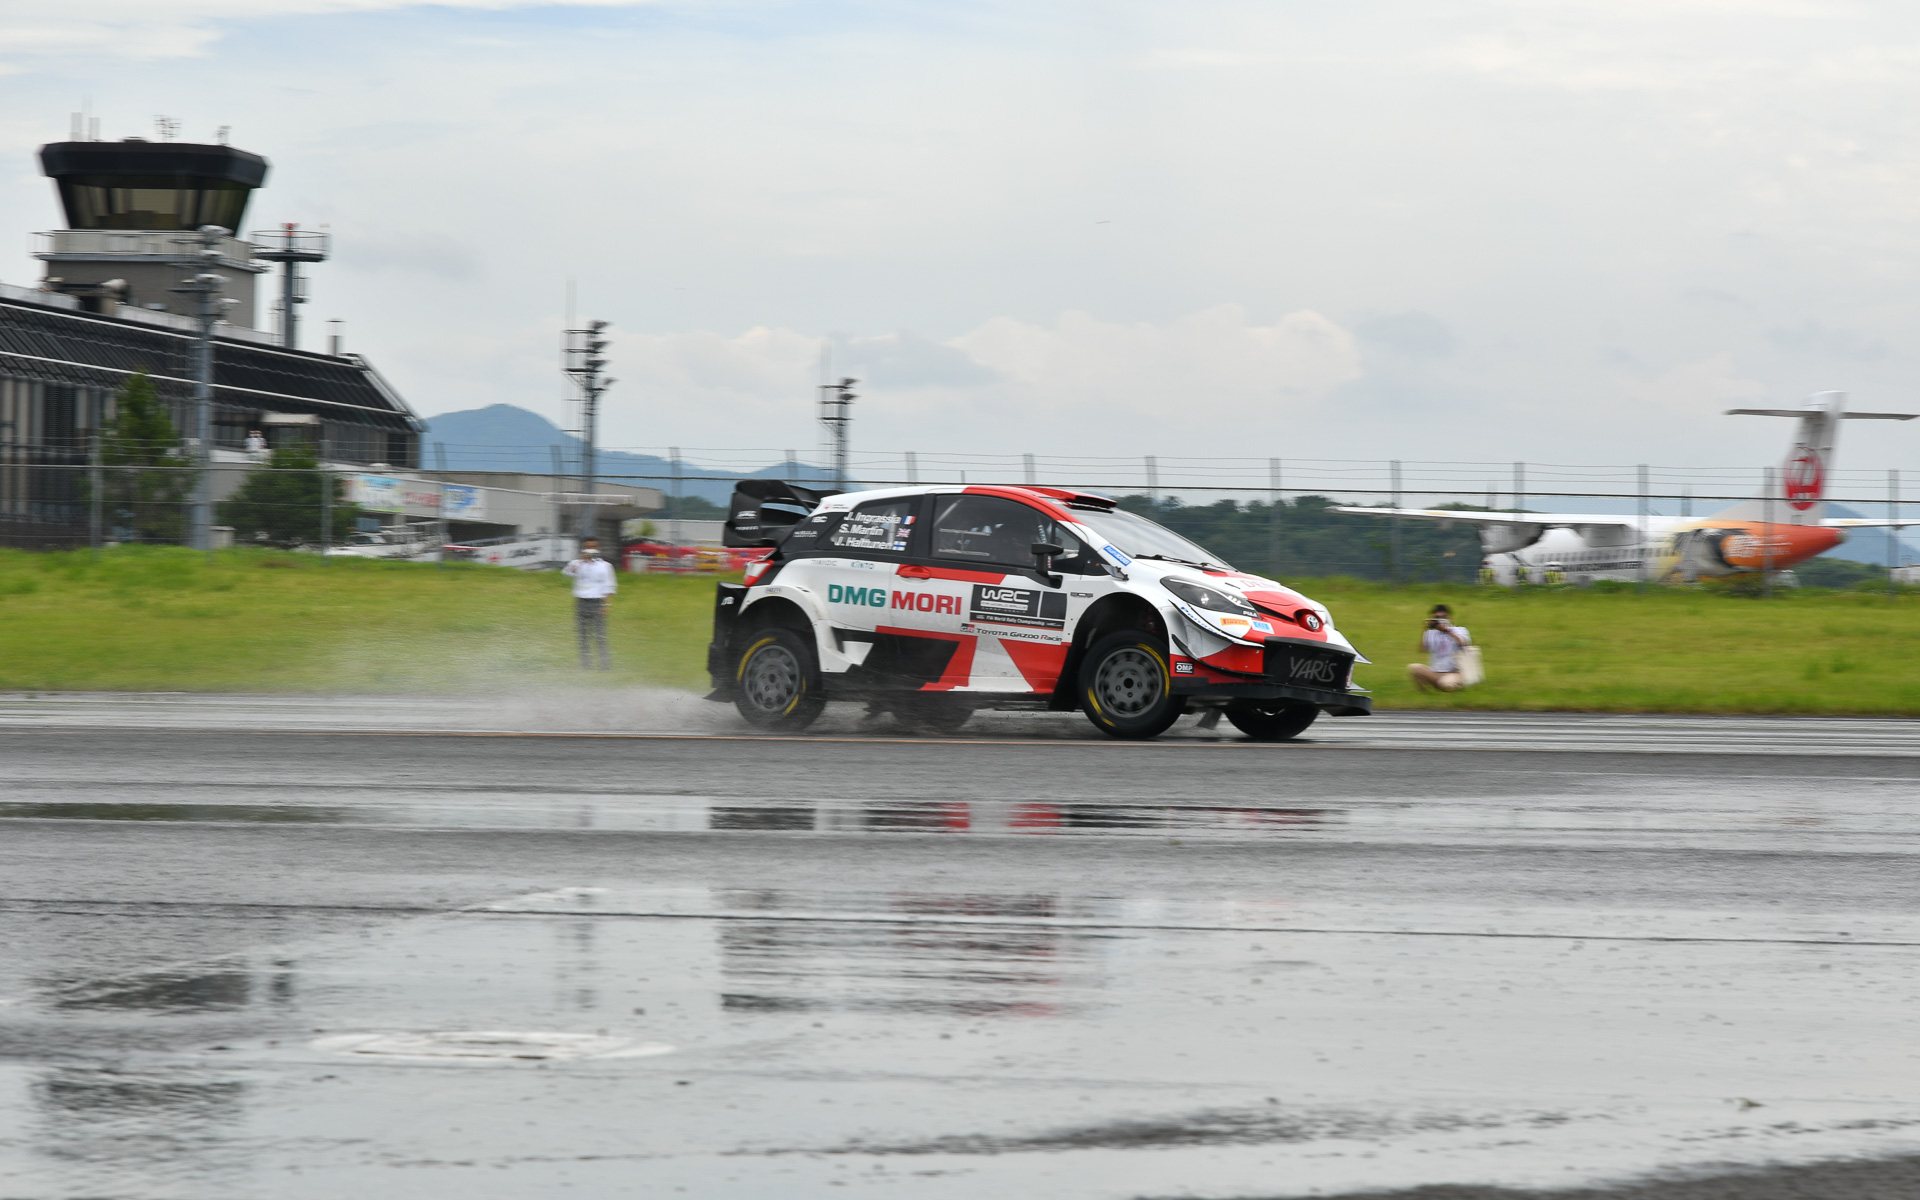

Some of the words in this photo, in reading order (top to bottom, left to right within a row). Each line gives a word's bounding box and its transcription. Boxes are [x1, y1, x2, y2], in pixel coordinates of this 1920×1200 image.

[844, 511, 854, 521] J.
[855, 512, 901, 524] Ingrassia
[839, 523, 850, 534] S.
[850, 524, 884, 536] Martin
[834, 536, 845, 546] J.
[828, 583, 886, 607] DMG
[891, 590, 962, 615] MORI
[981, 587, 1031, 603] WRC
[977, 628, 1008, 636] TOYOTA
[1009, 631, 1040, 640] GAZOO
[1041, 634, 1063, 642] Racin
[1176, 664, 1193, 672] OMP
